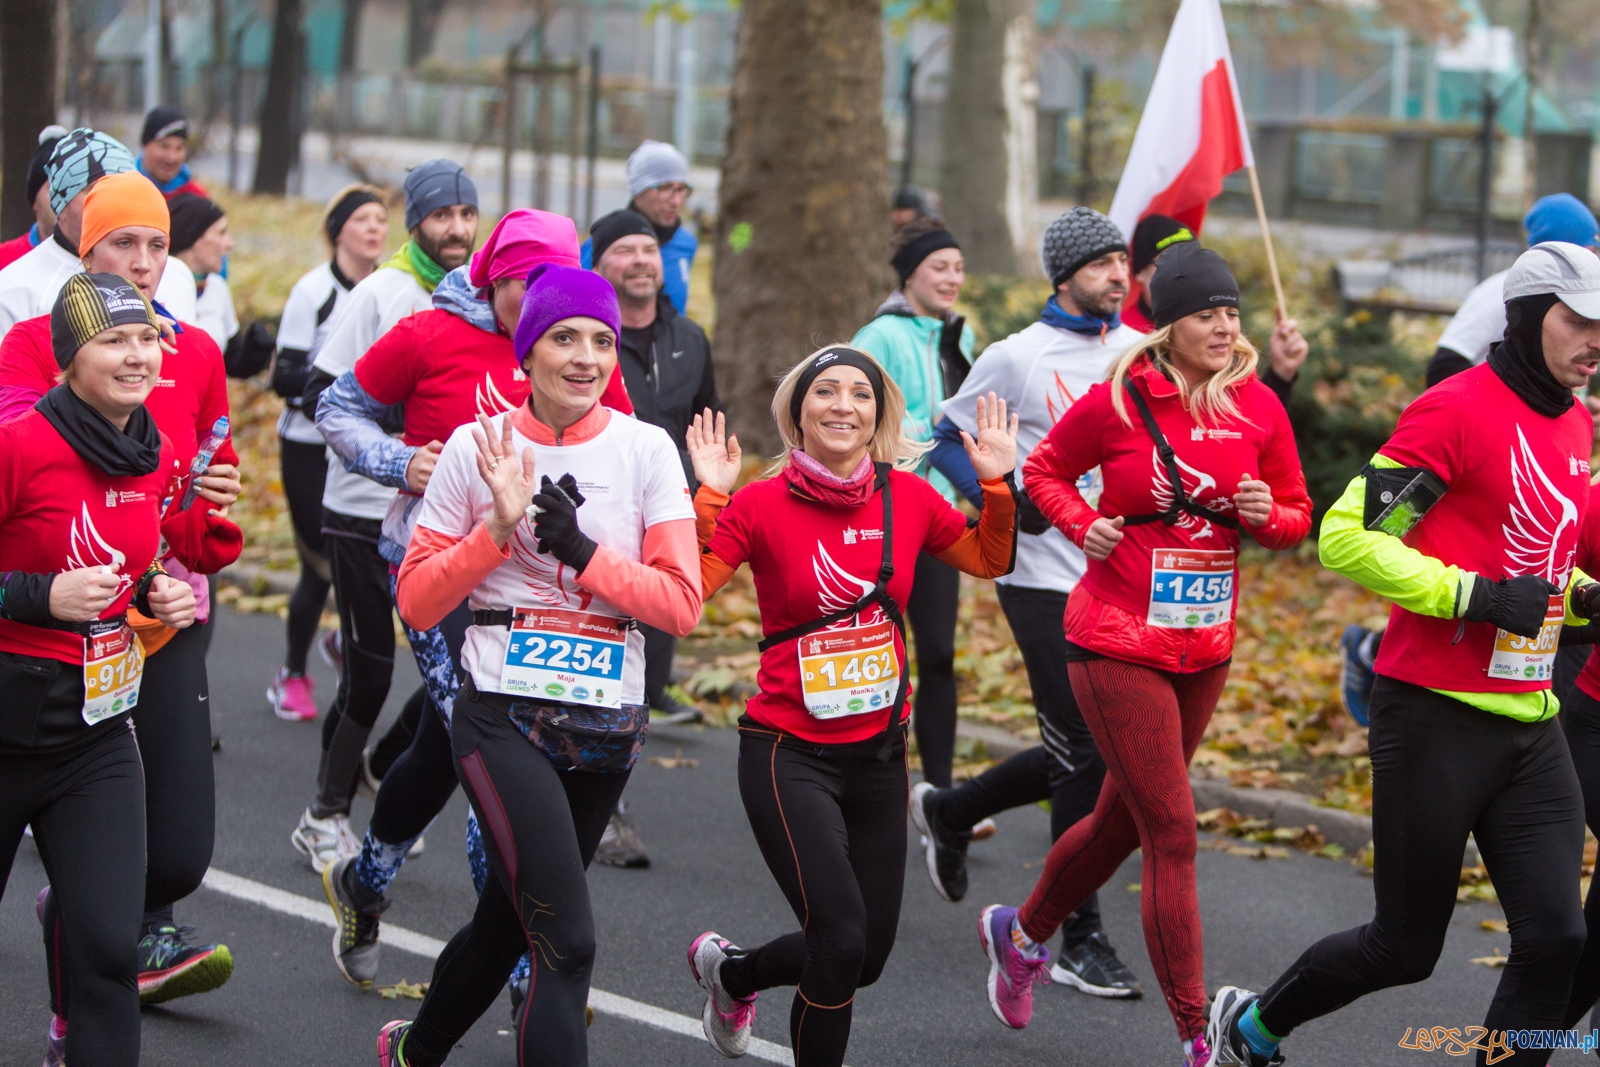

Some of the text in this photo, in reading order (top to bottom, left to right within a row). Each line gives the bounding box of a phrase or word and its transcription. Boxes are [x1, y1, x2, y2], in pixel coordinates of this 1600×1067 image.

[1156, 576, 1233, 602] E 1459
[539, 616, 544, 626] 1
[578, 622, 619, 636] RunPoland.org
[824, 640, 831, 649] 1
[510, 636, 612, 675] E 2254
[806, 651, 893, 687] D 1462
[88, 677, 97, 687] D
[557, 674, 575, 683] Maja
[850, 687, 875, 696] Monika
[811, 703, 831, 711] GRUPA
